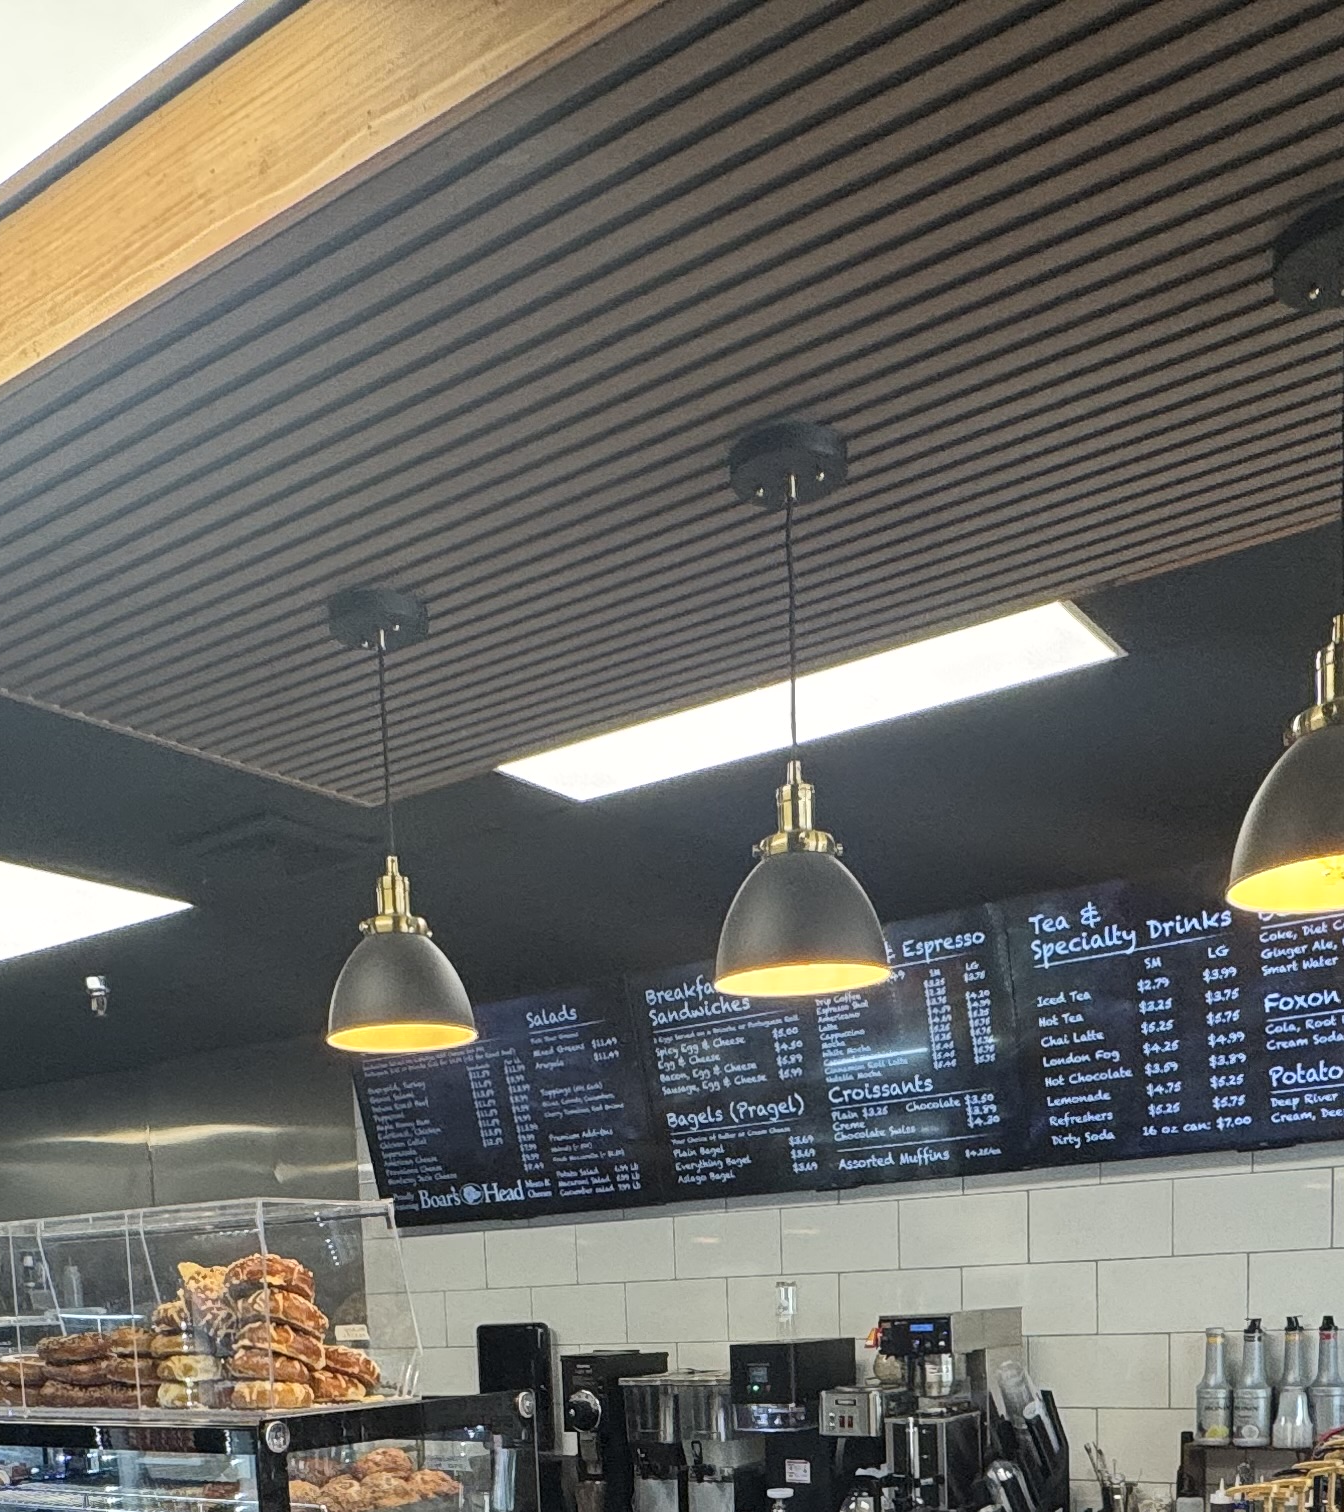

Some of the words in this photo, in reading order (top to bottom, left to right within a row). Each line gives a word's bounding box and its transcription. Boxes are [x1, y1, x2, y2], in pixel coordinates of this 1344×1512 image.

[1028, 914, 1070, 935] Tea
[1080, 901, 1101, 928] &
[1031, 924, 1136, 969] Specialty
[1146, 910, 1232, 939] Drinks
[1259, 929, 1298, 944] Coke,
[1302, 924, 1328, 936] Diet
[902, 931, 986, 964] Espresso
[1144, 957, 1162, 969] SM
[1208, 945, 1229, 959] LG
[1260, 944, 1308, 960] Ginger
[1311, 939, 1337, 951] Ale,
[1261, 960, 1298, 976] Smart
[1303, 956, 1339, 970] Water
[645, 974, 715, 1005] Breakfa
[1037, 992, 1067, 1008] Iced
[1069, 991, 1092, 1001] Tea
[1202, 967, 1237, 983] $3.99
[649, 996, 751, 1026] Sandwiches
[1264, 990, 1341, 1013] Foxon
[526, 1004, 577, 1028] Salads
[1039, 1015, 1059, 1027] Hot
[1061, 1013, 1084, 1023] Tea
[1265, 1022, 1300, 1035] Cola,
[1306, 1017, 1337, 1030] Root
[681, 1043, 699, 1055] Egg
[713, 1036, 746, 1047] Cheese
[1041, 1033, 1070, 1048] Chai
[1073, 1030, 1104, 1042] Latte
[1266, 1038, 1308, 1050] Cream
[1313, 1032, 1344, 1045] Soda
[658, 1061, 676, 1071] Egg
[689, 1054, 721, 1065] Cheese
[1043, 1053, 1091, 1068] London
[1095, 1050, 1120, 1062] Fog
[692, 1069, 711, 1080] Egg
[724, 1062, 757, 1073] Cheese
[1045, 1076, 1065, 1088] Hot
[1069, 1067, 1133, 1084] Chocolate
[1269, 1060, 1343, 1087] Potato
[702, 1081, 720, 1092] Egg
[734, 1074, 768, 1085] Cheese
[828, 1074, 934, 1104] Croissants
[831, 1110, 858, 1121] Plain
[906, 1097, 961, 1113] Chocolate
[1047, 1091, 1112, 1107] Lemonade
[1270, 1096, 1300, 1111] Deep
[1304, 1092, 1338, 1104] River
[666, 1106, 724, 1131] Bagels
[730, 1092, 805, 1123] (Pragel)
[1049, 1112, 1113, 1126] Refreshers
[1271, 1111, 1316, 1124] Cream,
[833, 1121, 866, 1132] Creme
[834, 1130, 886, 1142] Chocolate
[1052, 1131, 1082, 1148] Dirty
[1086, 1129, 1115, 1142] Soda
[1162, 1126, 1179, 1134] oz
[1216, 1116, 1252, 1131] $7.00
[673, 1149, 697, 1158] Plain
[700, 1144, 725, 1155] Bagel
[838, 1152, 895, 1170] Assorted
[899, 1147, 950, 1166] Muffins
[675, 1160, 724, 1173] Everything
[726, 1155, 752, 1167] Bagel
[710, 1170, 736, 1182] Bagel
[418, 1186, 461, 1209] Boar's
[482, 1179, 525, 1203] Head
